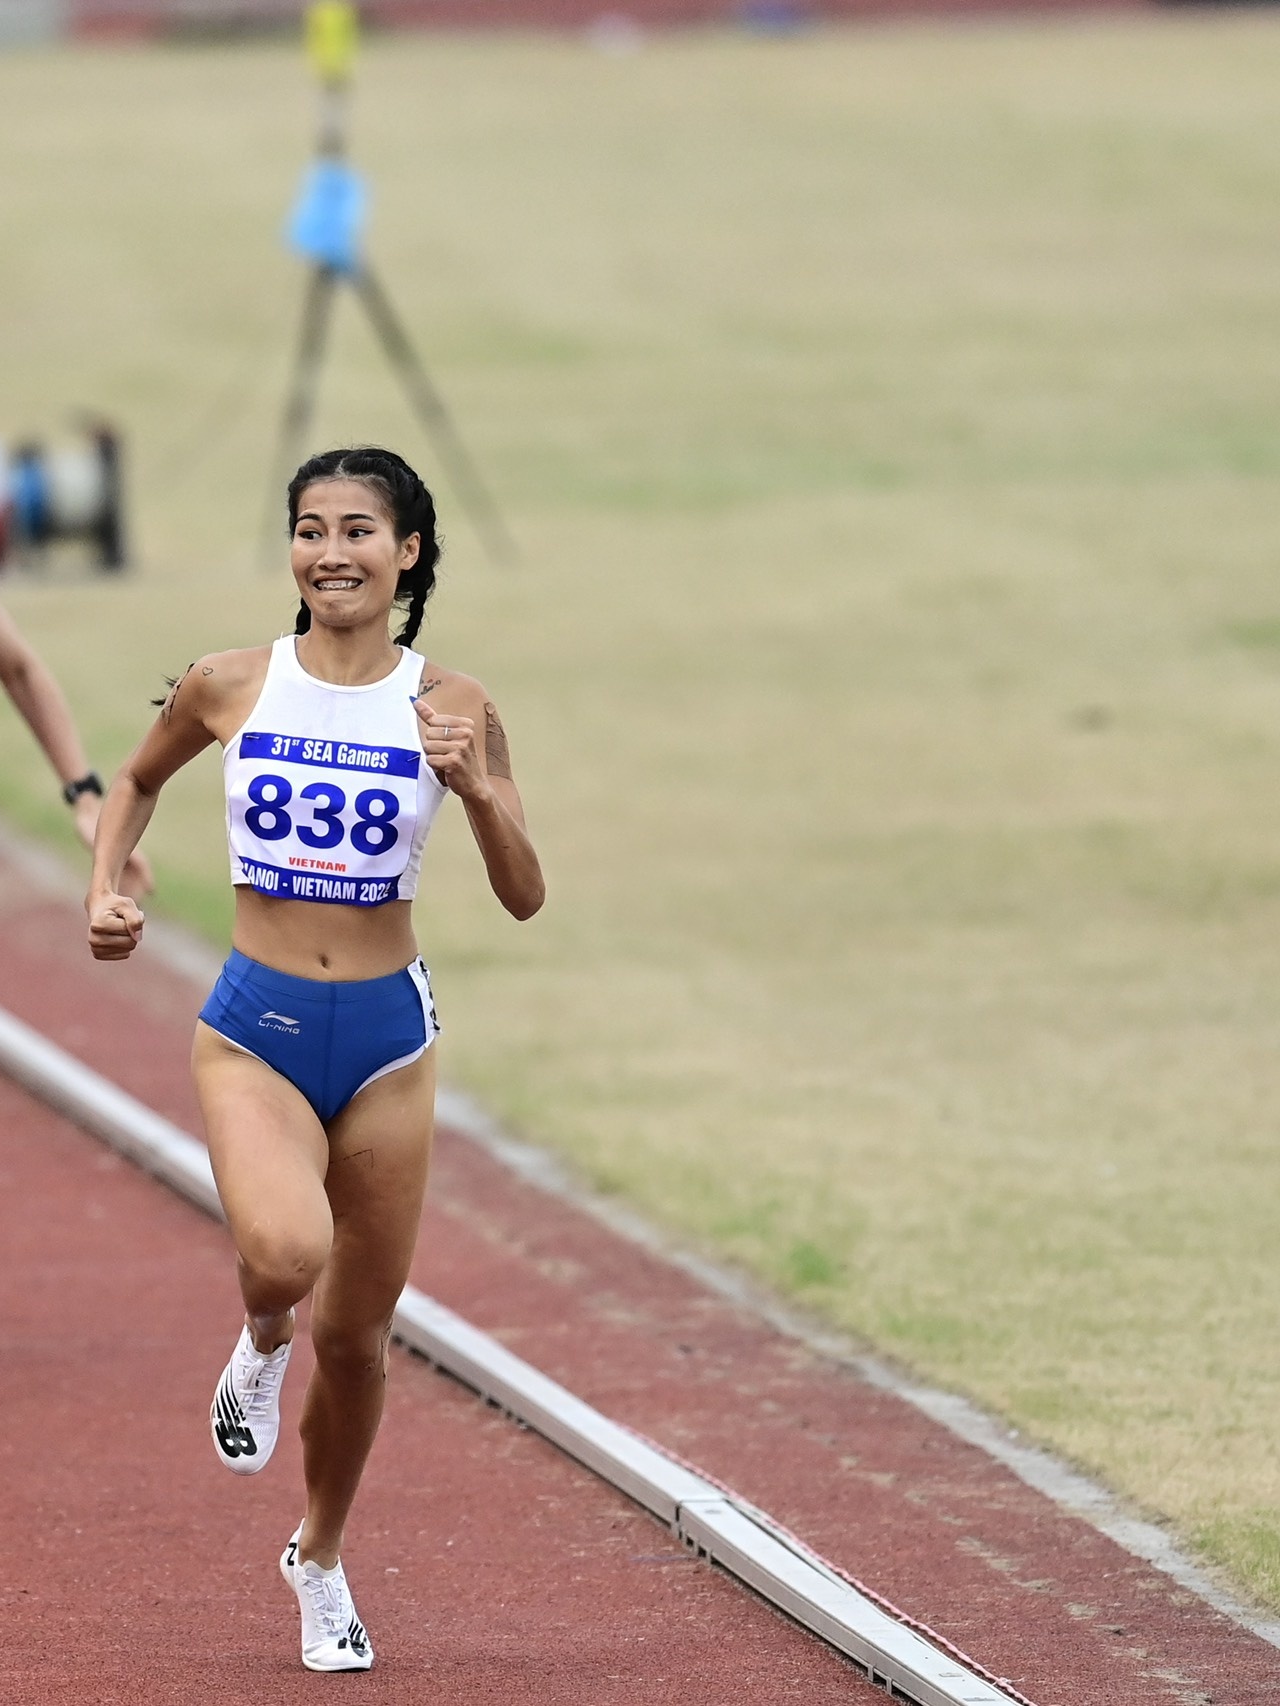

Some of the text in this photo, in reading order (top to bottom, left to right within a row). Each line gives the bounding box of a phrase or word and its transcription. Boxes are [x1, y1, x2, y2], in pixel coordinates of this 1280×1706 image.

[302, 739, 334, 766] SEA
[337, 743, 389, 769] Games
[244, 774, 400, 856] 838
[288, 856, 346, 872] VIETNAM
[292, 875, 356, 900] VIETNAM
[258, 1019, 300, 1035] LI-NING
